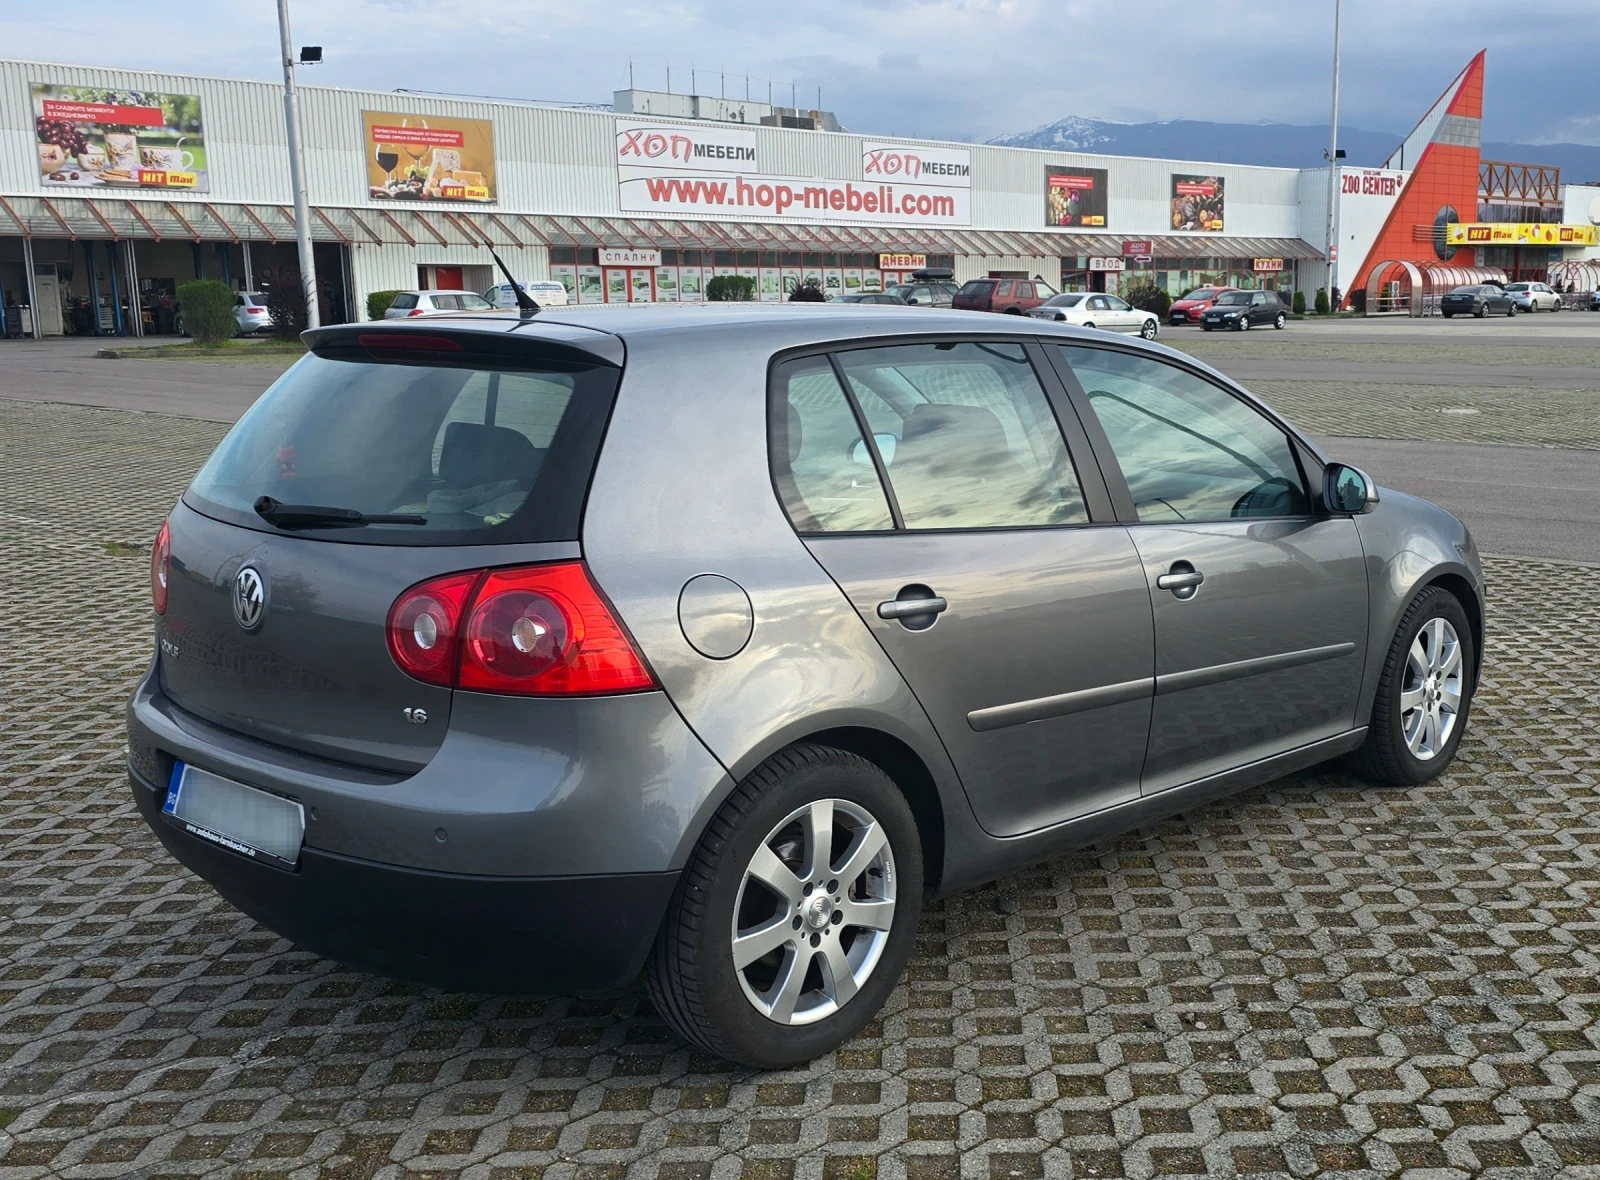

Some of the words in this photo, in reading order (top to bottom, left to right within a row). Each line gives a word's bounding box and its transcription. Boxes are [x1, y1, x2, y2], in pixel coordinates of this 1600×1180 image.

[55, 104, 86, 112] СЛАДКИТЕ
[619, 130, 693, 163] ХОП
[694, 143, 755, 161] МЕБЕЛИ
[865, 150, 921, 179] ХОП
[922, 161, 970, 177] МЕБЕЛИ
[142, 172, 164, 183] HIT
[1342, 175, 1360, 194] ZOO
[1362, 176, 1396, 196] CENTER
[446, 187, 463, 196] HIT
[646, 176, 955, 217] www.hop-mebeli.com
[1470, 229, 1490, 239] HIT
[605, 252, 656, 262] СПАЛНИ
[882, 255, 925, 267] ДНЕВНИ
[1095, 259, 1120, 269] ВХОД
[1255, 260, 1283, 269] КУХНИ
[186, 823, 256, 857] www.autohaus-farnbacher.de
